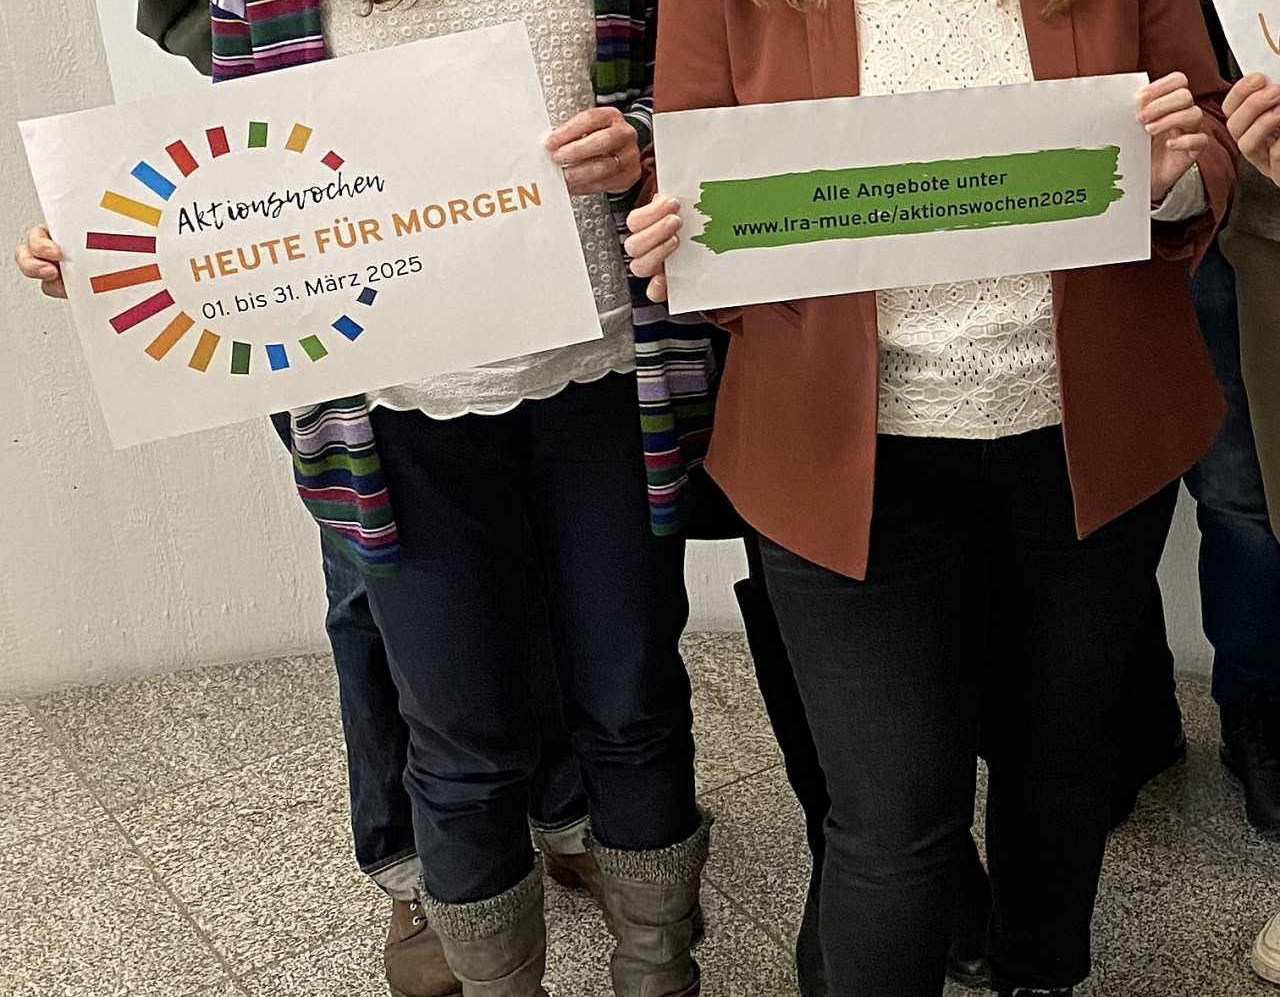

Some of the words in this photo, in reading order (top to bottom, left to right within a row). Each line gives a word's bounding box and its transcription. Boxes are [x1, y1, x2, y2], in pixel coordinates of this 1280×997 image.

[177, 172, 385, 235] Aktionswochen
[733, 188, 1087, 237] www.lra-mue.de/aktionswochen2025
[812, 183, 850, 202] Alle
[856, 176, 950, 199] Angebote
[956, 171, 1008, 190] unter
[189, 234, 306, 282] HEUTE
[315, 217, 383, 254] FÜR
[392, 182, 542, 237] MORGEN
[201, 298, 232, 320] 01.
[235, 290, 268, 315] bis
[273, 282, 300, 307] 31.
[305, 269, 361, 297] März
[366, 256, 423, 283] 2025
